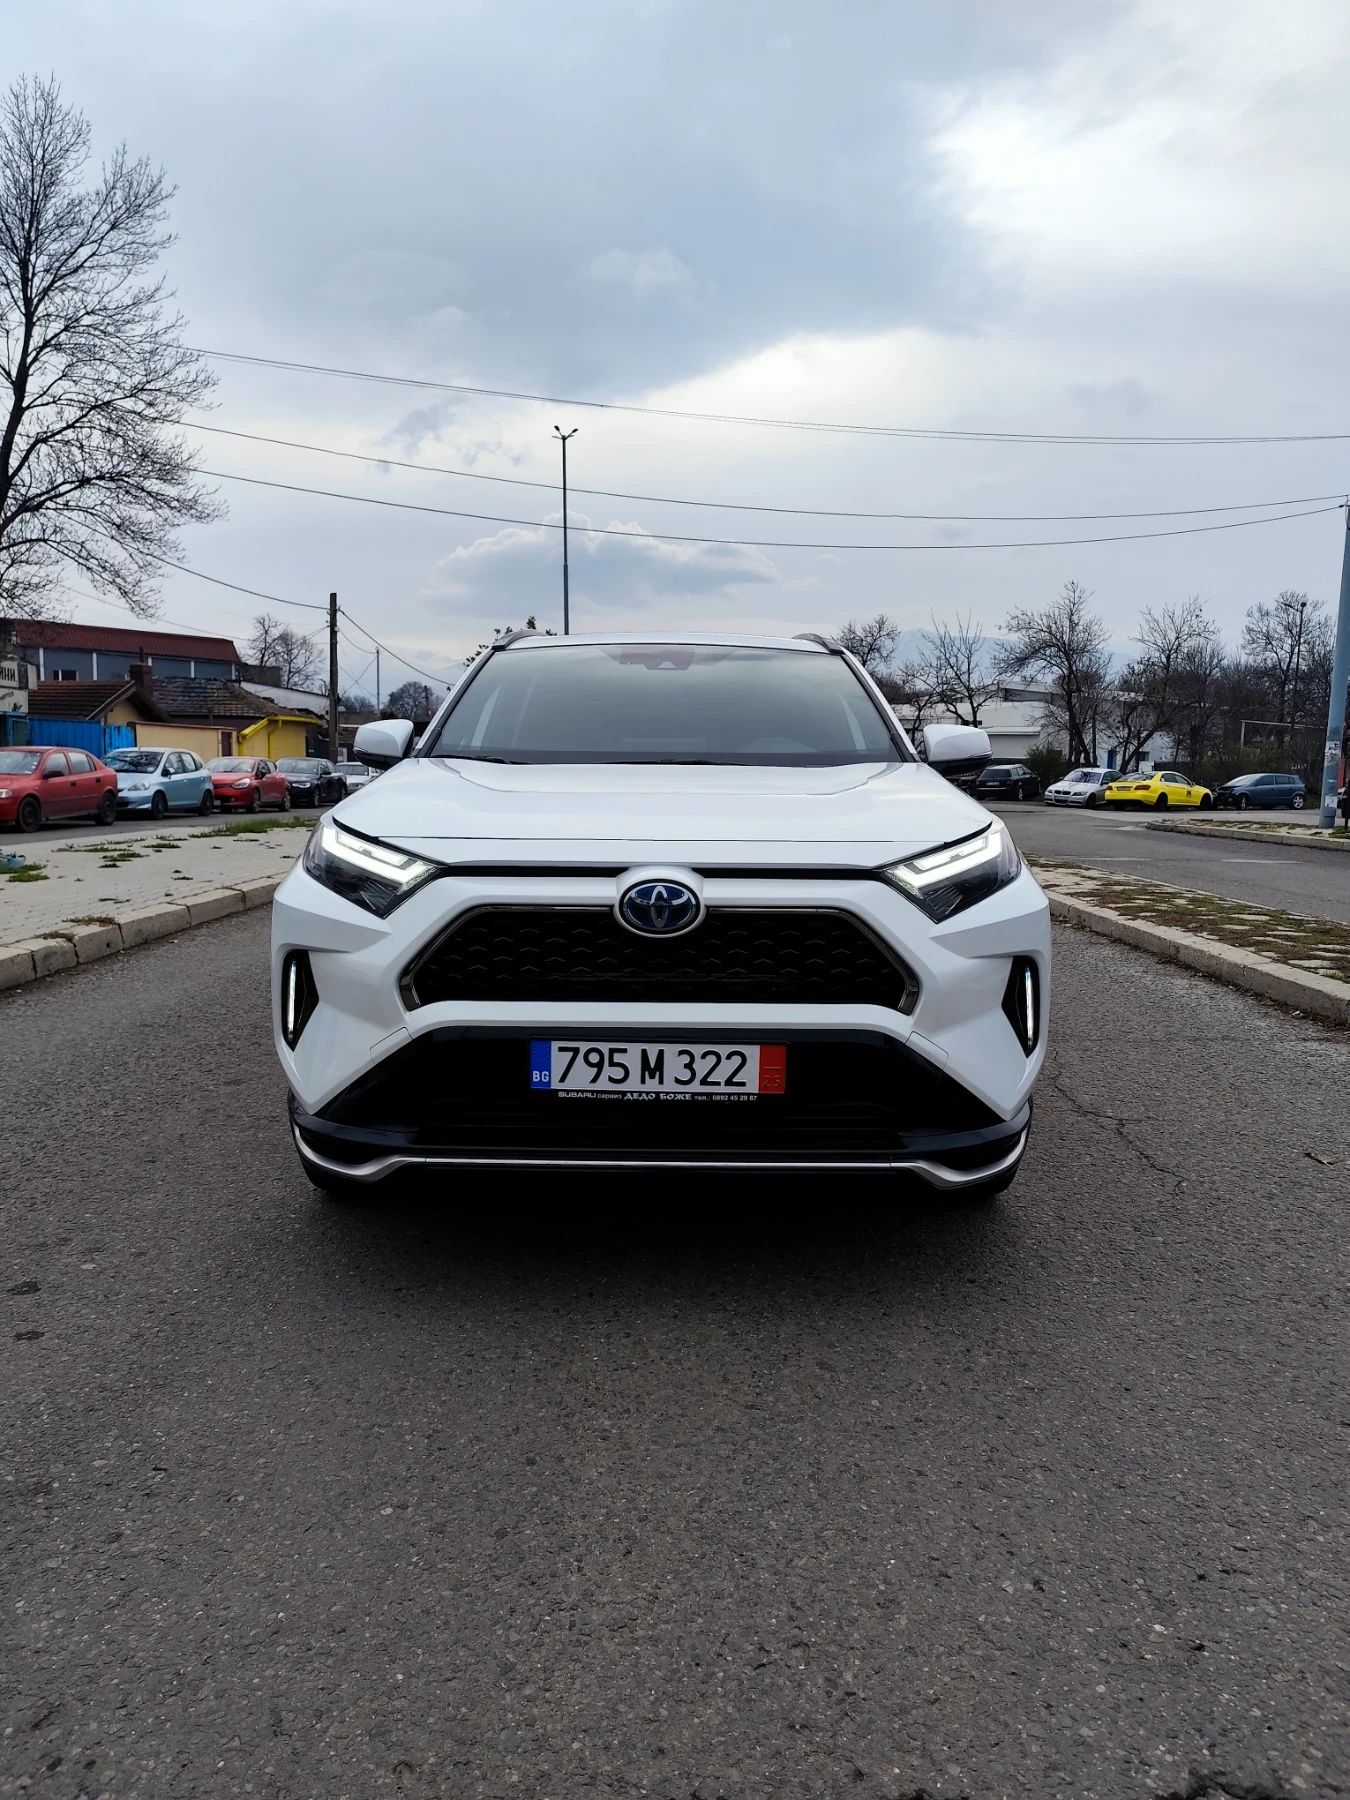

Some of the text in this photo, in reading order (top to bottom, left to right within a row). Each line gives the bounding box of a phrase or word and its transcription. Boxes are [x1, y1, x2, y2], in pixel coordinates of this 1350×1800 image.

[558, 1046, 747, 1087] 795 M 322
[532, 1071, 550, 1082] BG
[763, 1074, 781, 1088] 25
[624, 1092, 656, 1100] ДЕДО
